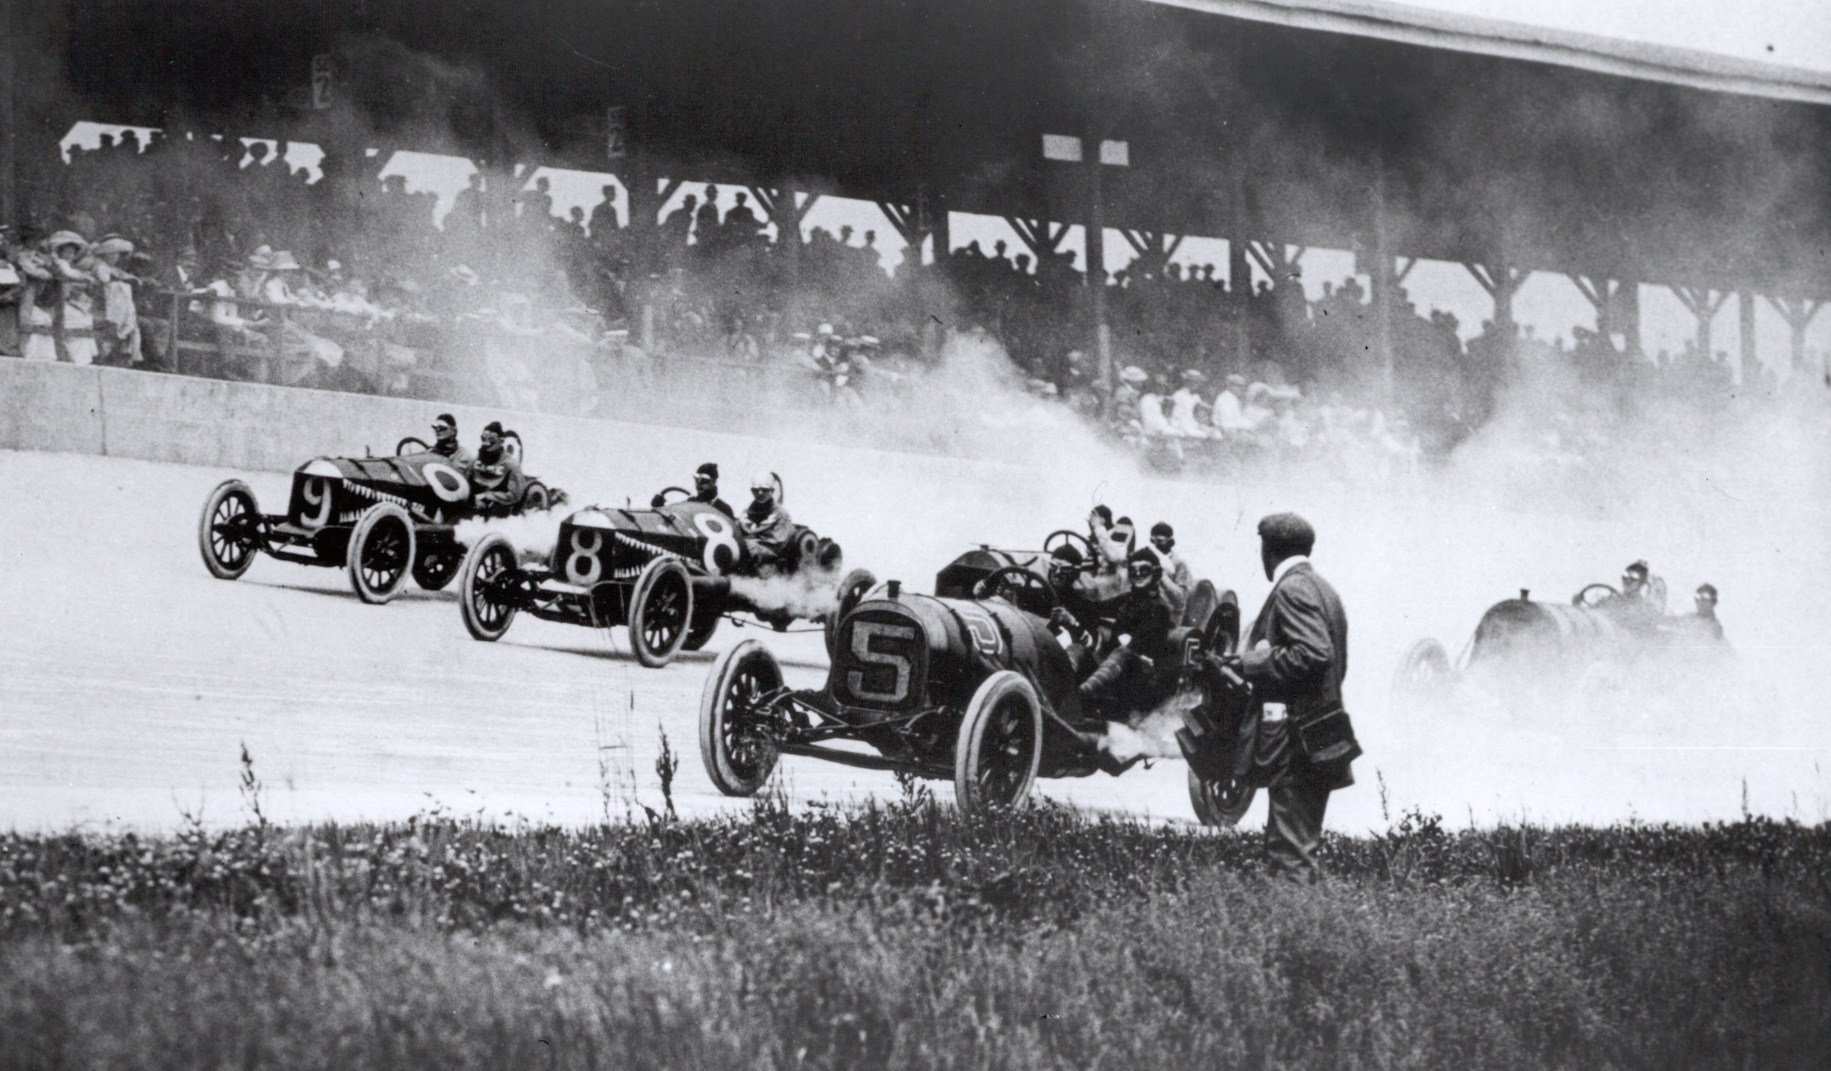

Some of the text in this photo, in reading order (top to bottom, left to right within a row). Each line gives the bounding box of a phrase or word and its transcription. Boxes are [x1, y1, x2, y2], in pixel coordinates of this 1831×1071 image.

[301, 476, 332, 528] 9
[565, 527, 602, 585] 8
[694, 512, 740, 576] 8
[847, 620, 915, 702] 5
